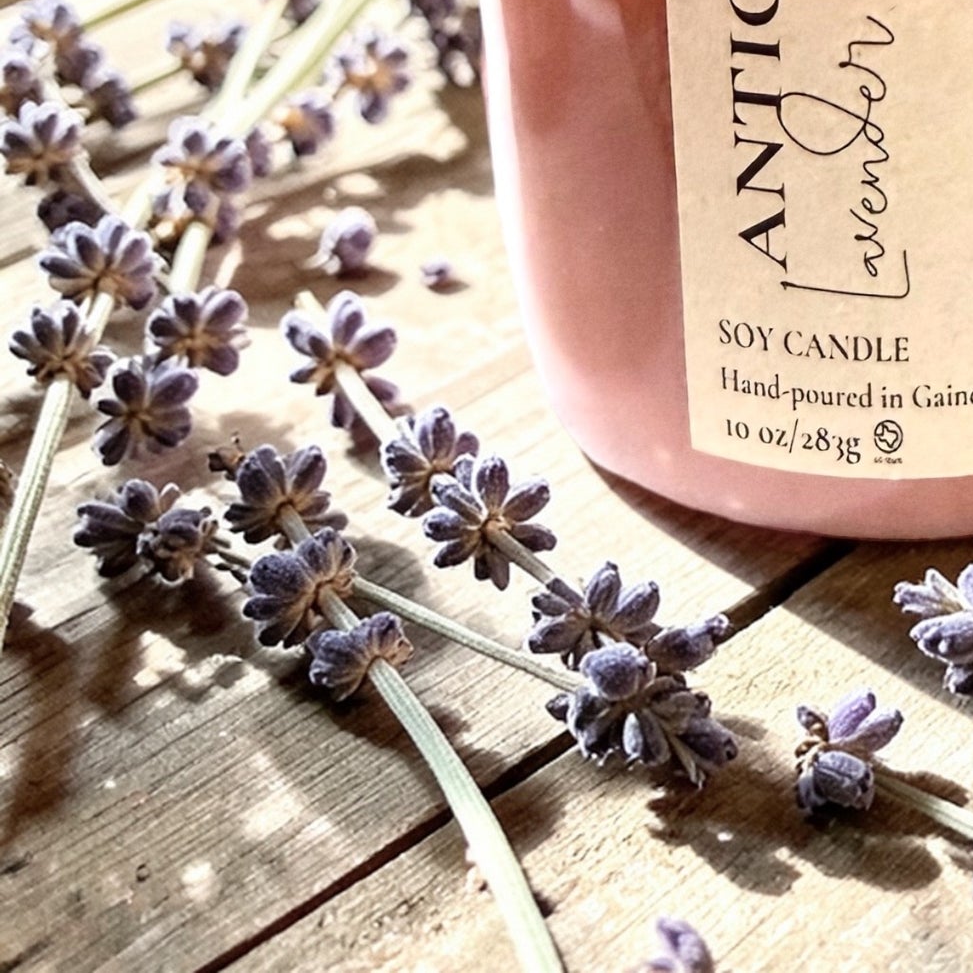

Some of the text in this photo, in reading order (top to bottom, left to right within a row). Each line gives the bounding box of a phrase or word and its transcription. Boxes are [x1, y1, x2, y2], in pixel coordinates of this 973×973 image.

[776, 15, 910, 298] Lavender
[718, 319, 910, 363] SOY CANDLE
[720, 367, 873, 411] Hand-poured
[881, 386, 903, 409] in
[725, 418, 750, 440] 10
